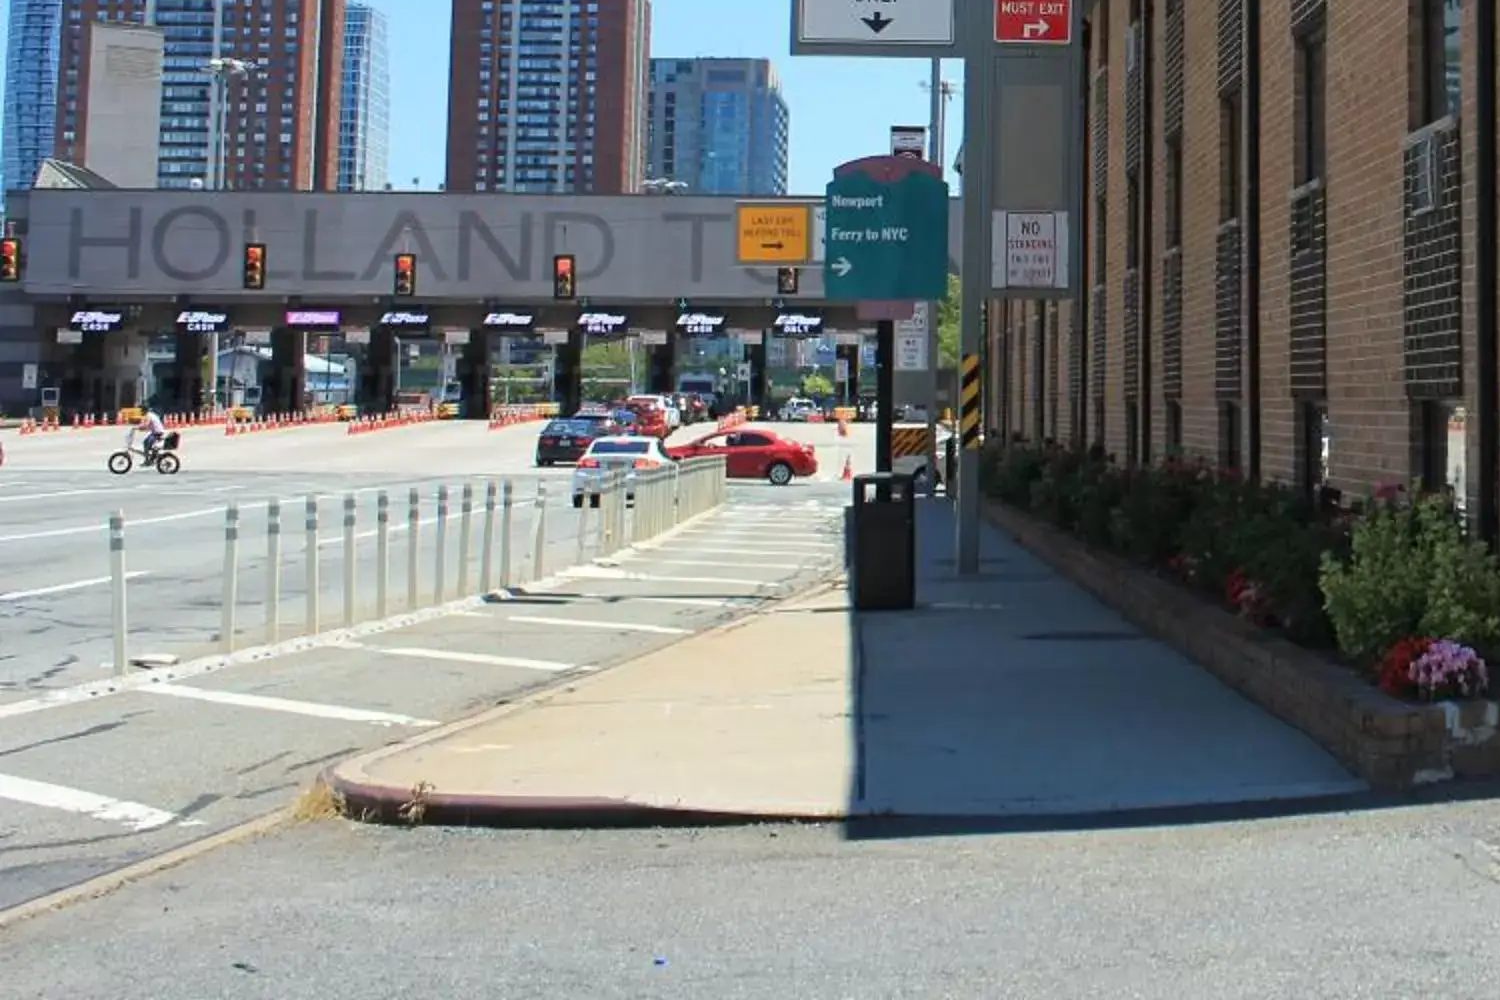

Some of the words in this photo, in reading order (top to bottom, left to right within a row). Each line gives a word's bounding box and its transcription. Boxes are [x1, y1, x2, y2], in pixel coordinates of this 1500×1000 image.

[1001, 1, 1034, 15] MUST
[1039, 2, 1064, 16] EXIT
[832, 195, 883, 209] Newport
[832, 226, 863, 242] Ferry
[865, 228, 879, 241] to
[881, 227, 909, 241] NYC
[1021, 221, 1041, 236] NO
[68, 205, 615, 281] HOLLAND
